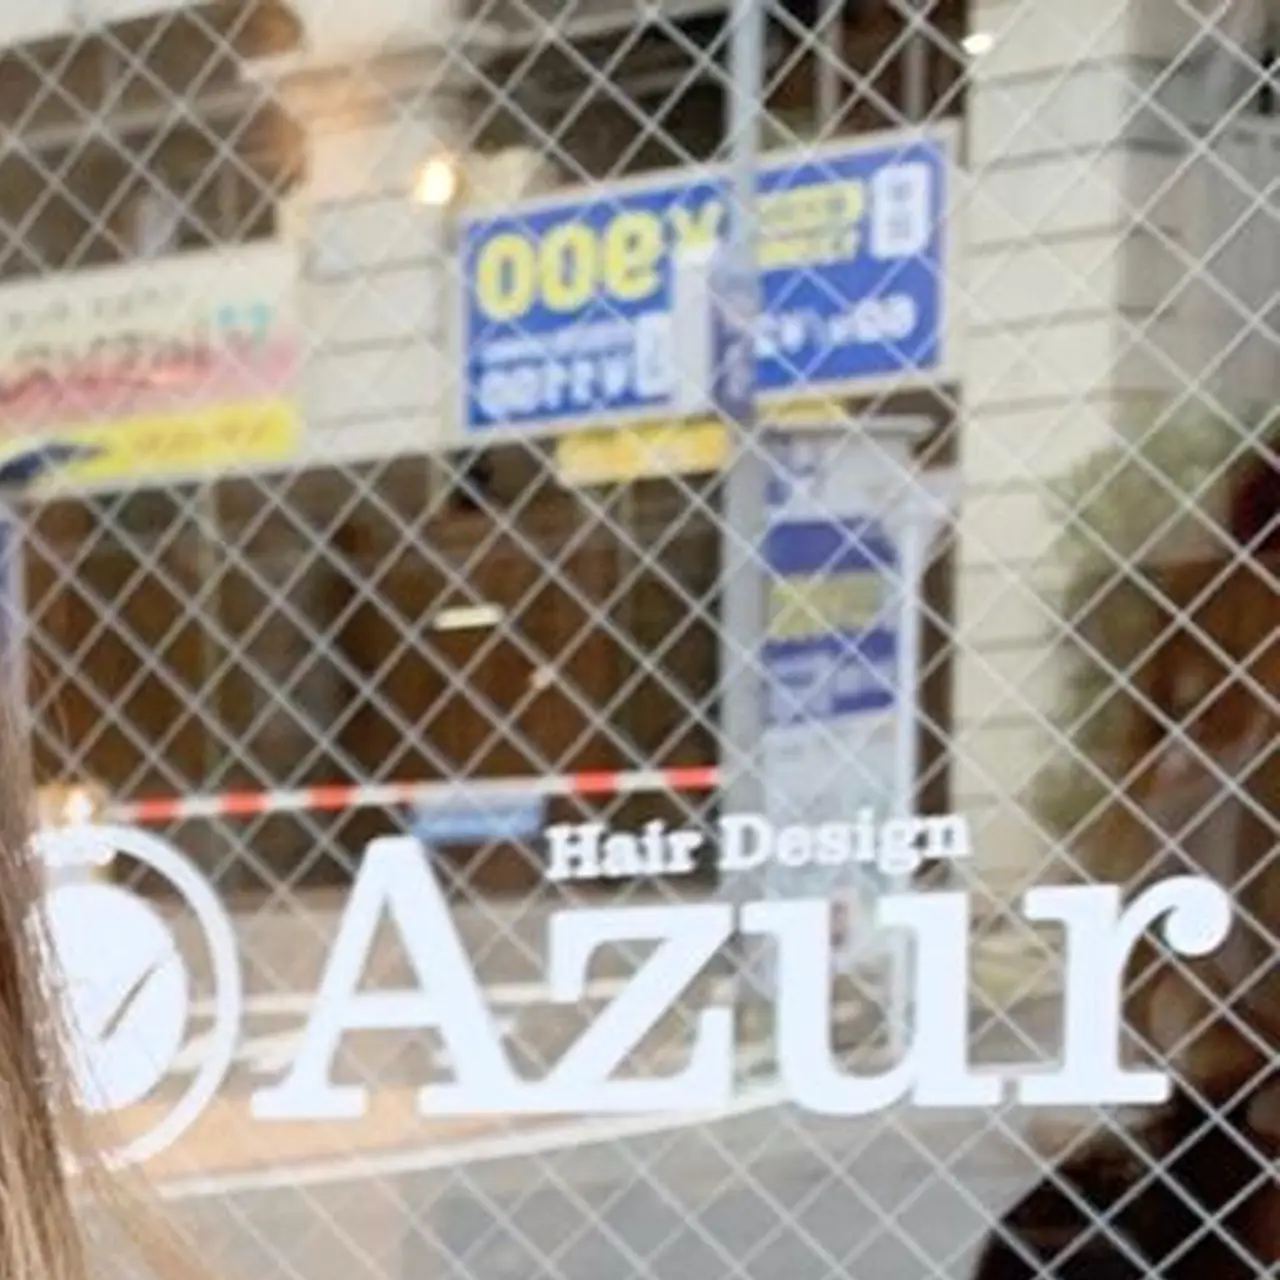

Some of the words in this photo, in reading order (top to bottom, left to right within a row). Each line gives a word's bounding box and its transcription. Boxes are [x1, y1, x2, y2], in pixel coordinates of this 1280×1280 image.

[543, 820, 705, 882] Hair
[718, 806, 971, 876] Design
[251, 836, 1232, 1118] Azur
